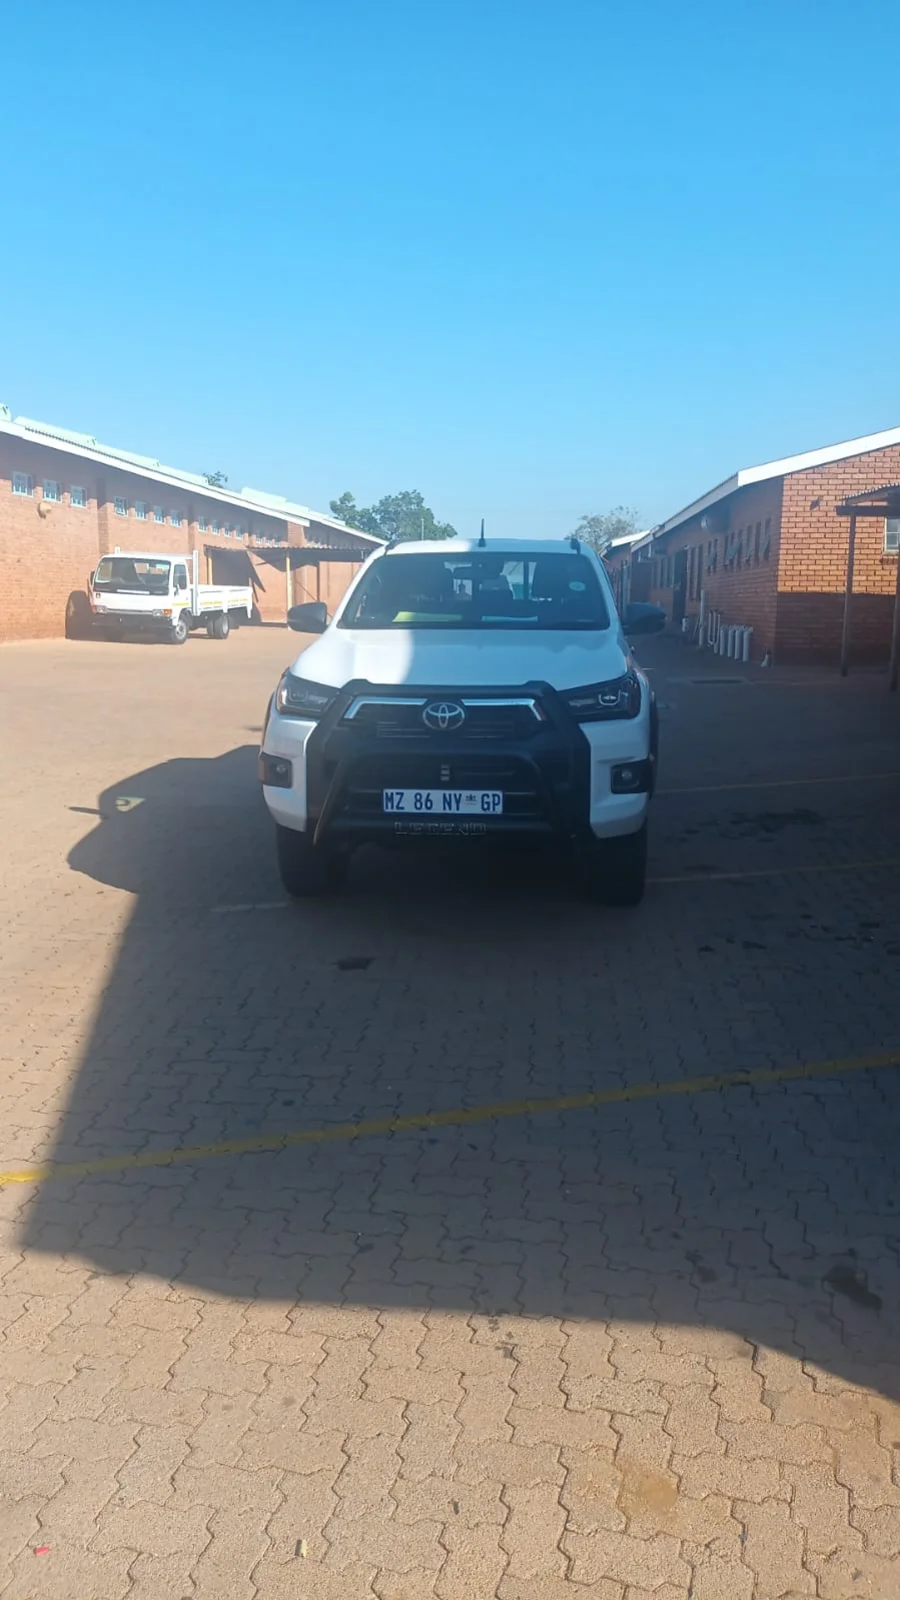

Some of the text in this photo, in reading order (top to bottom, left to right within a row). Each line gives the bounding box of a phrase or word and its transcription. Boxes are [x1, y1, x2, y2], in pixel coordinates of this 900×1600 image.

[385, 792, 501, 812] MZ 86 NY GP
